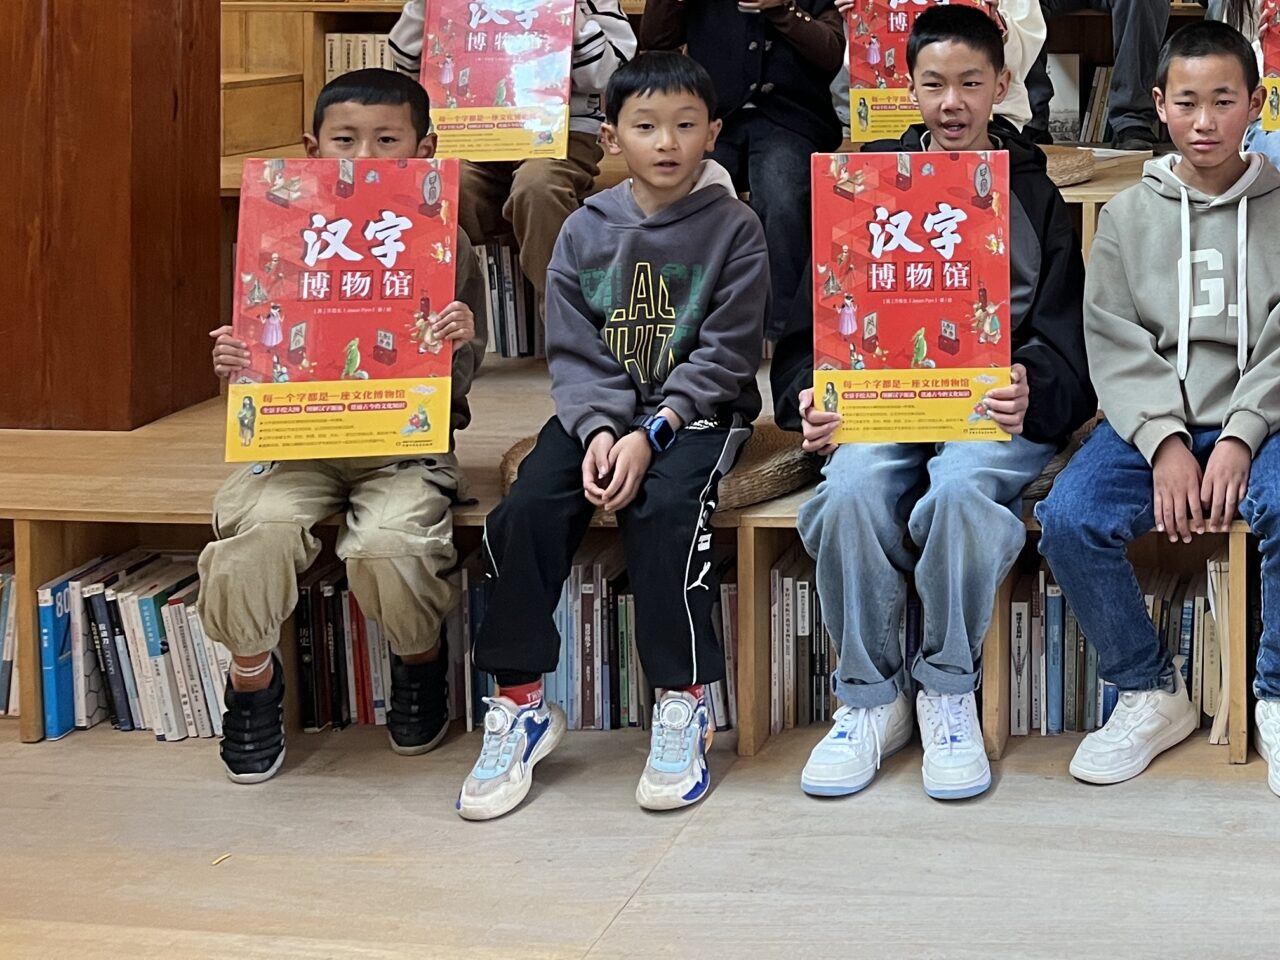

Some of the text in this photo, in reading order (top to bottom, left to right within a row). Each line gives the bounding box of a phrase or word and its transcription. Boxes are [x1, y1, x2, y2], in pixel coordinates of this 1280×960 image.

[302, 210, 413, 268] 汉字
[868, 203, 968, 260] 汉字
[300, 270, 413, 300] 博物馆
[868, 262, 970, 290] 博物馆
[262, 390, 406, 403] 每一个字都是一座文化博物馆
[843, 378, 970, 389] 每一个字都是一座文化博物馆
